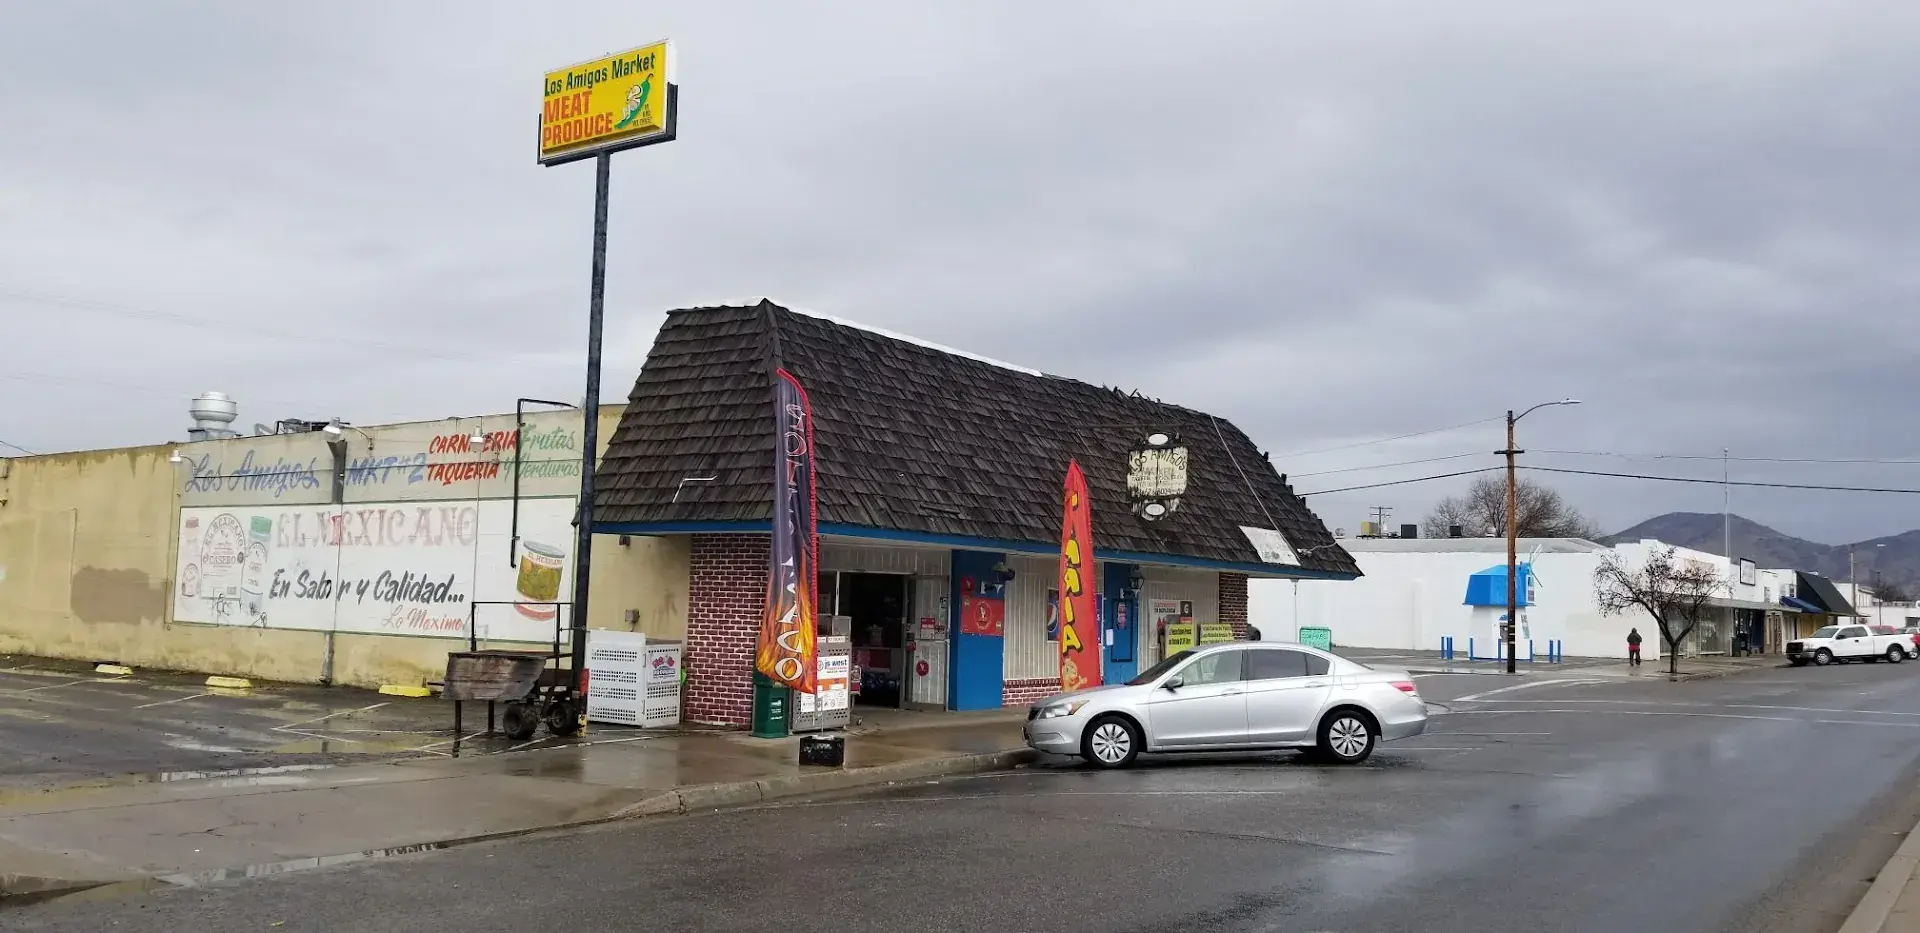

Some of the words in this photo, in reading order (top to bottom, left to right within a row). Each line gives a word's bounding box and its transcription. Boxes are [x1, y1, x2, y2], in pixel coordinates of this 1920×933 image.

[544, 77, 563, 97] Los
[566, 66, 608, 90] Amigos
[612, 52, 656, 79] Market
[543, 90, 593, 124] MEAT
[542, 111, 614, 147] PRODUCE
[429, 430, 517, 455] CARNERIA
[184, 453, 222, 493] Los
[227, 449, 320, 498] Amigos
[345, 455, 397, 487] MKT
[427, 461, 500, 486] TAQUERIA
[1128, 455, 1148, 475] LOS
[276, 513, 305, 548] EL
[312, 505, 477, 548] MEXICANO
[209, 555, 237, 566] CASERO
[268, 568, 291, 600] En
[355, 578, 370, 605] y
